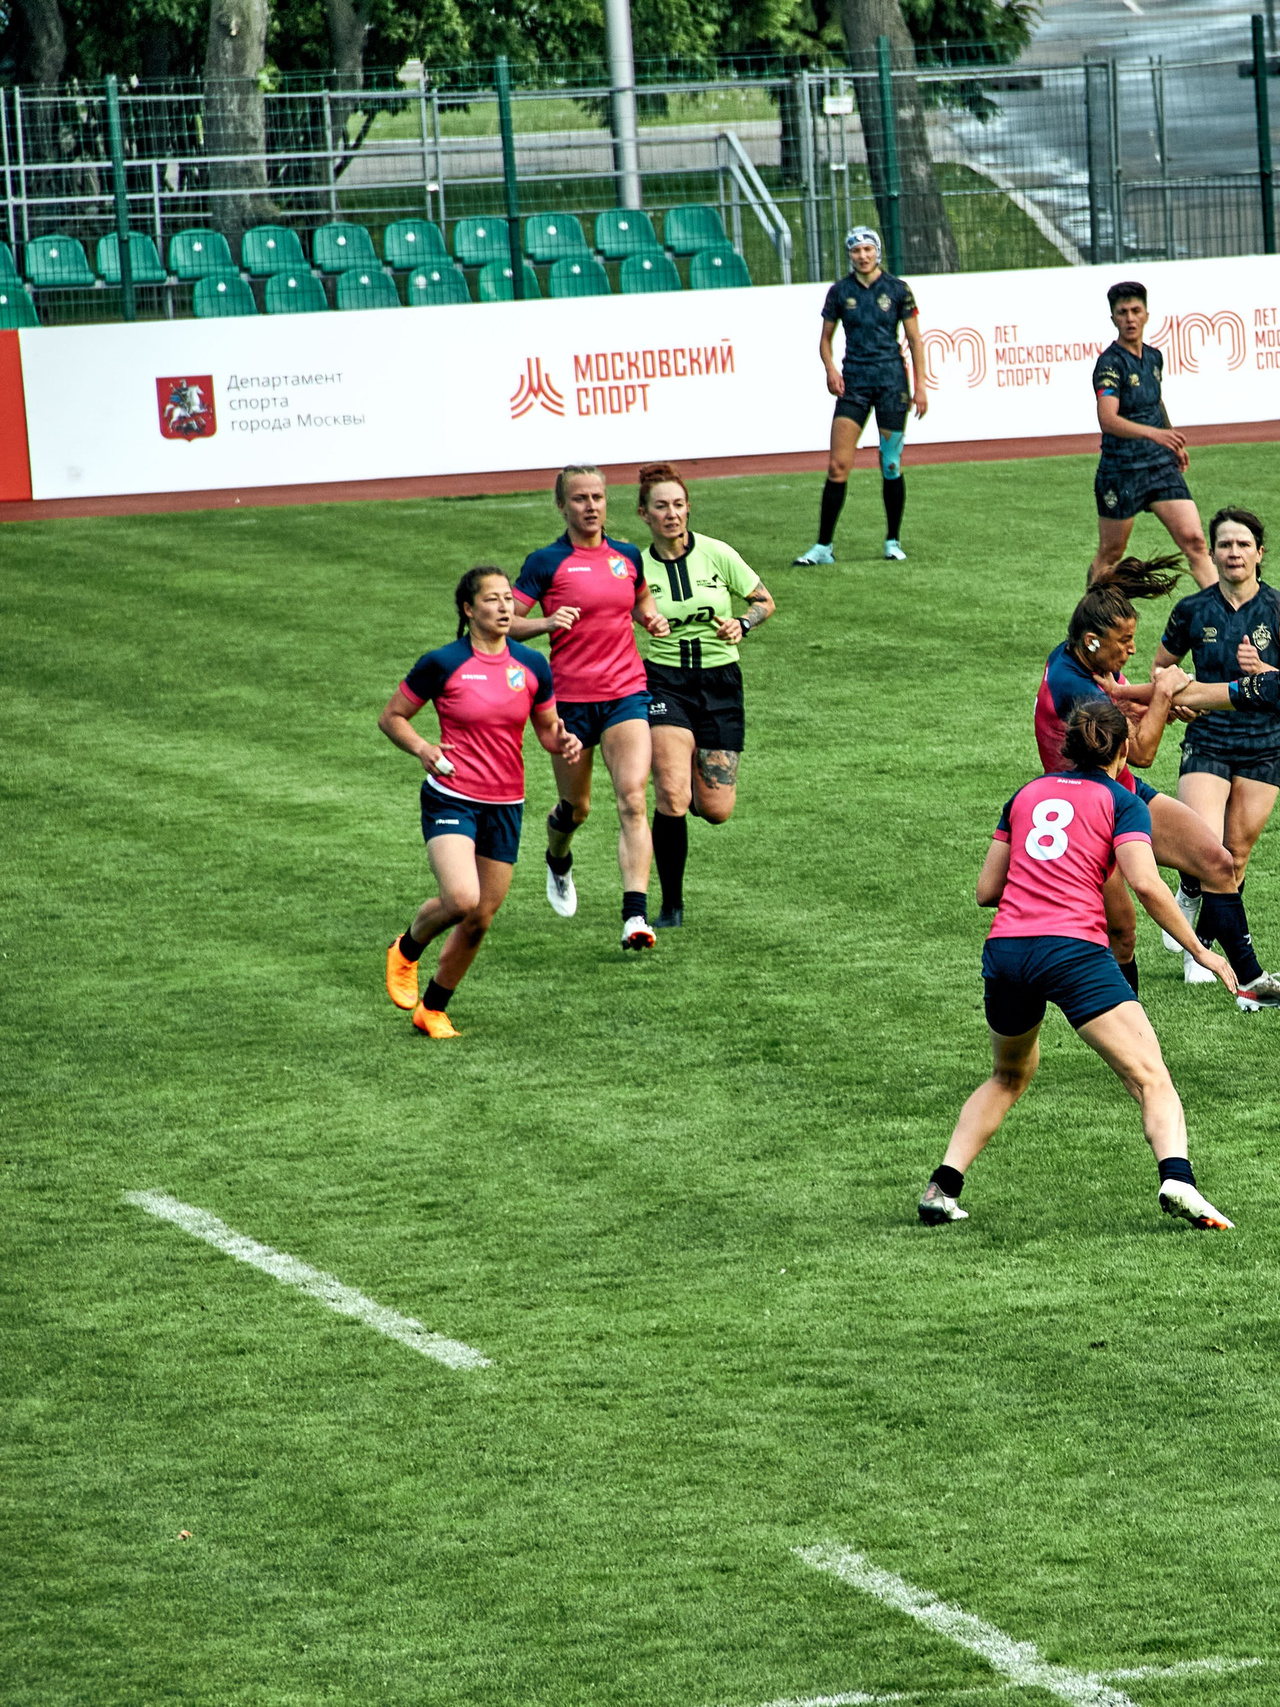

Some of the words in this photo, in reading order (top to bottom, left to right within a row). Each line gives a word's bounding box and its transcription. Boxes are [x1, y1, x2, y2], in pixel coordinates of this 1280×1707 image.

[1254, 308, 1278, 327] ЛЕТ
[994, 324, 1018, 344] ЛЕТ
[573, 338, 735, 383] МОСКОВСКИЙ
[995, 342, 1103, 365] МОСКОВСКОМУ
[227, 372, 343, 391] Департамент
[996, 367, 1051, 388] СПОРТУ
[229, 396, 289, 412] спорта
[576, 384, 651, 416] СПОРТ
[231, 416, 291, 434] города
[297, 413, 365, 428] Москвы
[1025, 798, 1075, 861] 8
